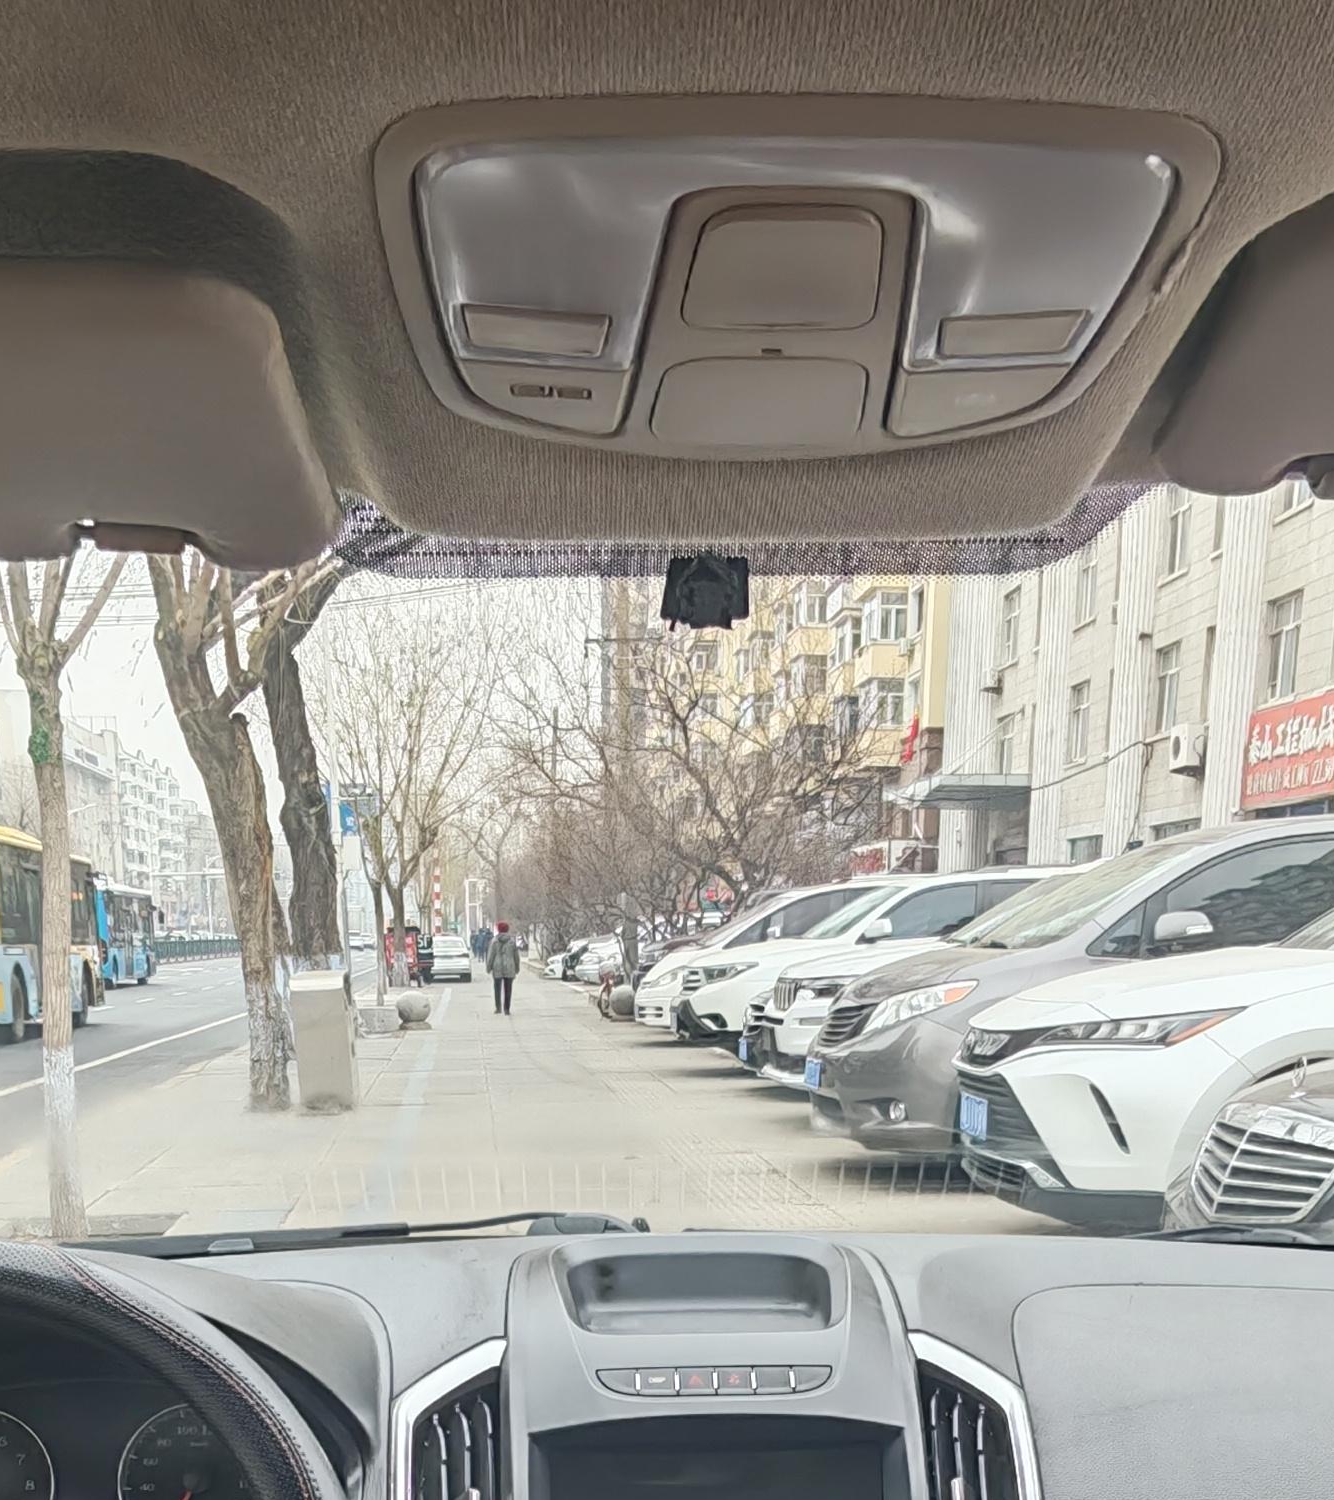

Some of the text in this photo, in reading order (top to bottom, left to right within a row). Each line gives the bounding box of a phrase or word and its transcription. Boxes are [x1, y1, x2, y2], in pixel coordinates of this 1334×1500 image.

[16, 1454, 26, 1466] 7
[25, 1480, 35, 1491] 8
[140, 1482, 155, 1492] 40
